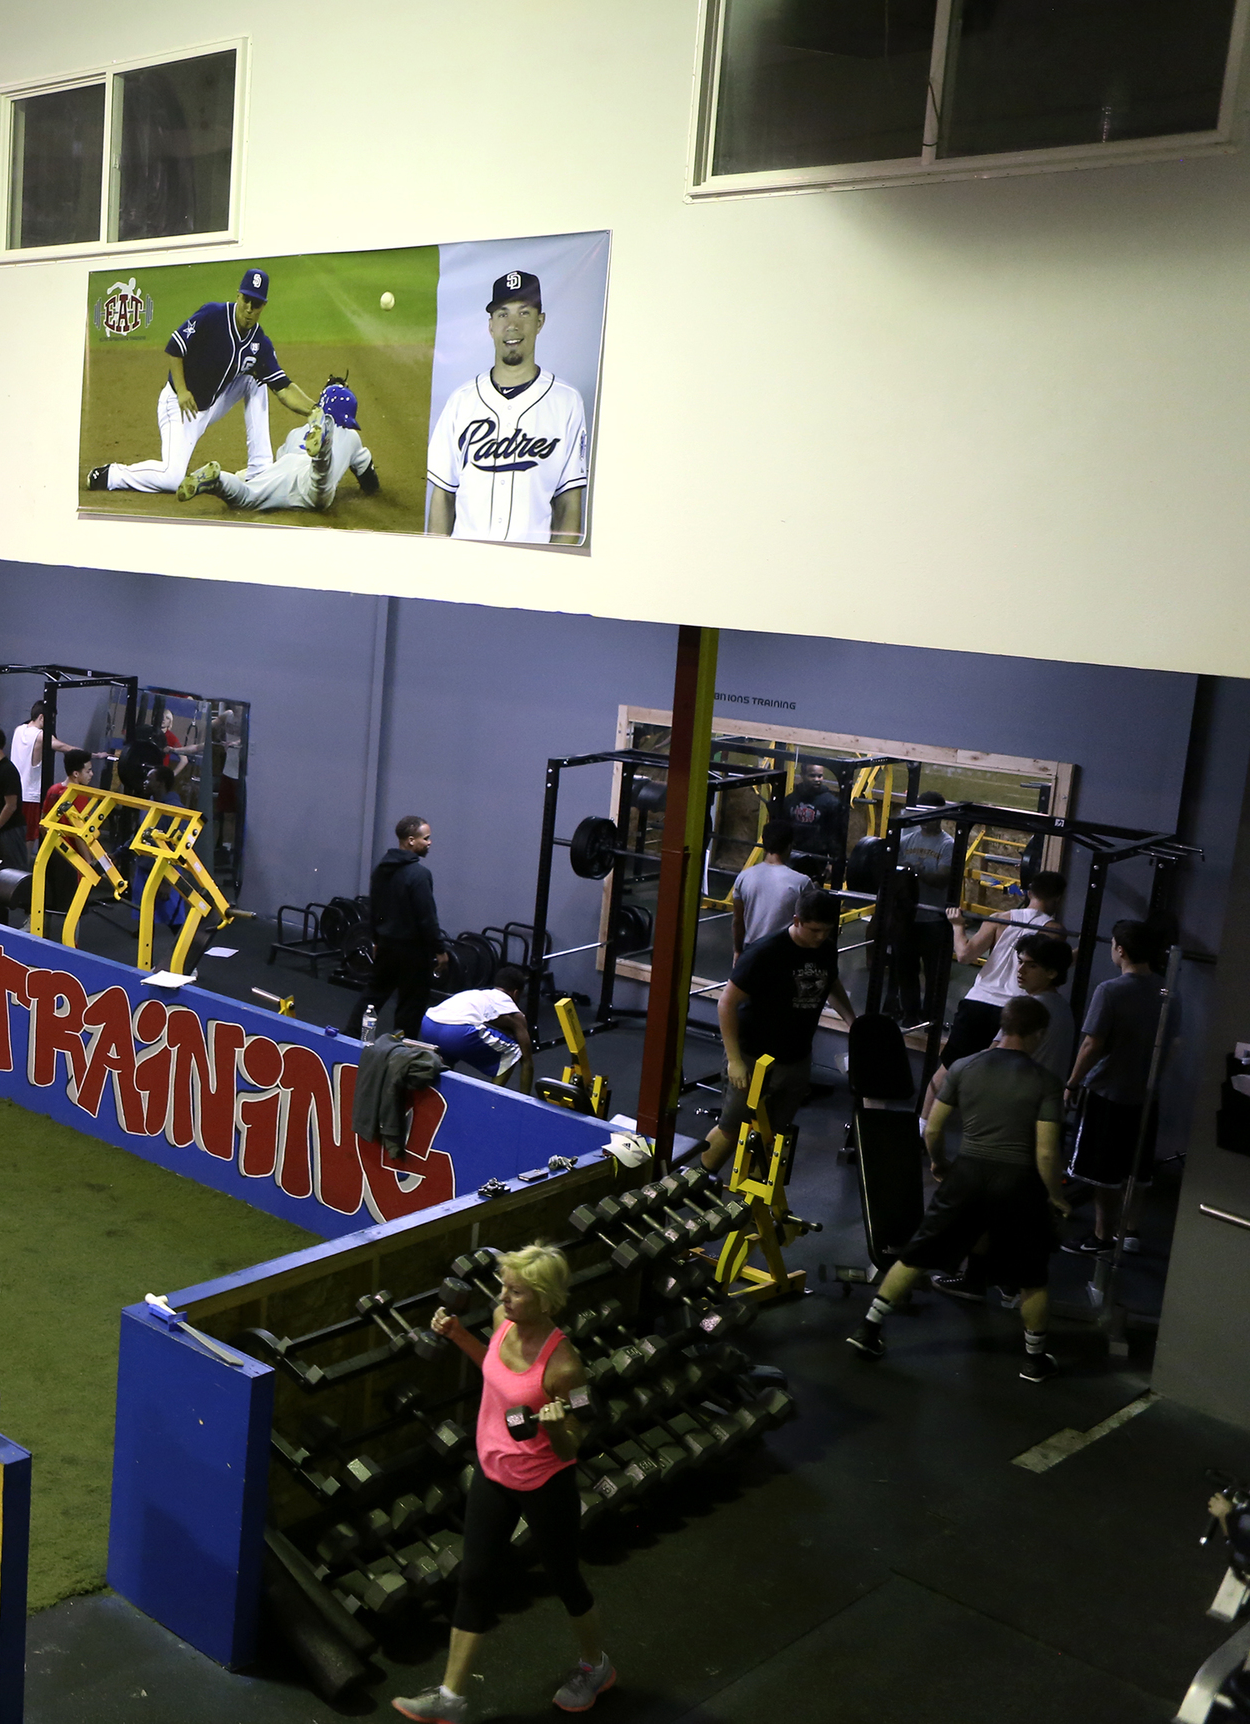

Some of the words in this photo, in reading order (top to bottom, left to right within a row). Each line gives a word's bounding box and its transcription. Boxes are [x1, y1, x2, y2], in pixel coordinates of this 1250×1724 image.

[103, 294, 144, 333] EAT
[458, 417, 561, 472] Padres
[752, 696, 797, 710] TRAINING
